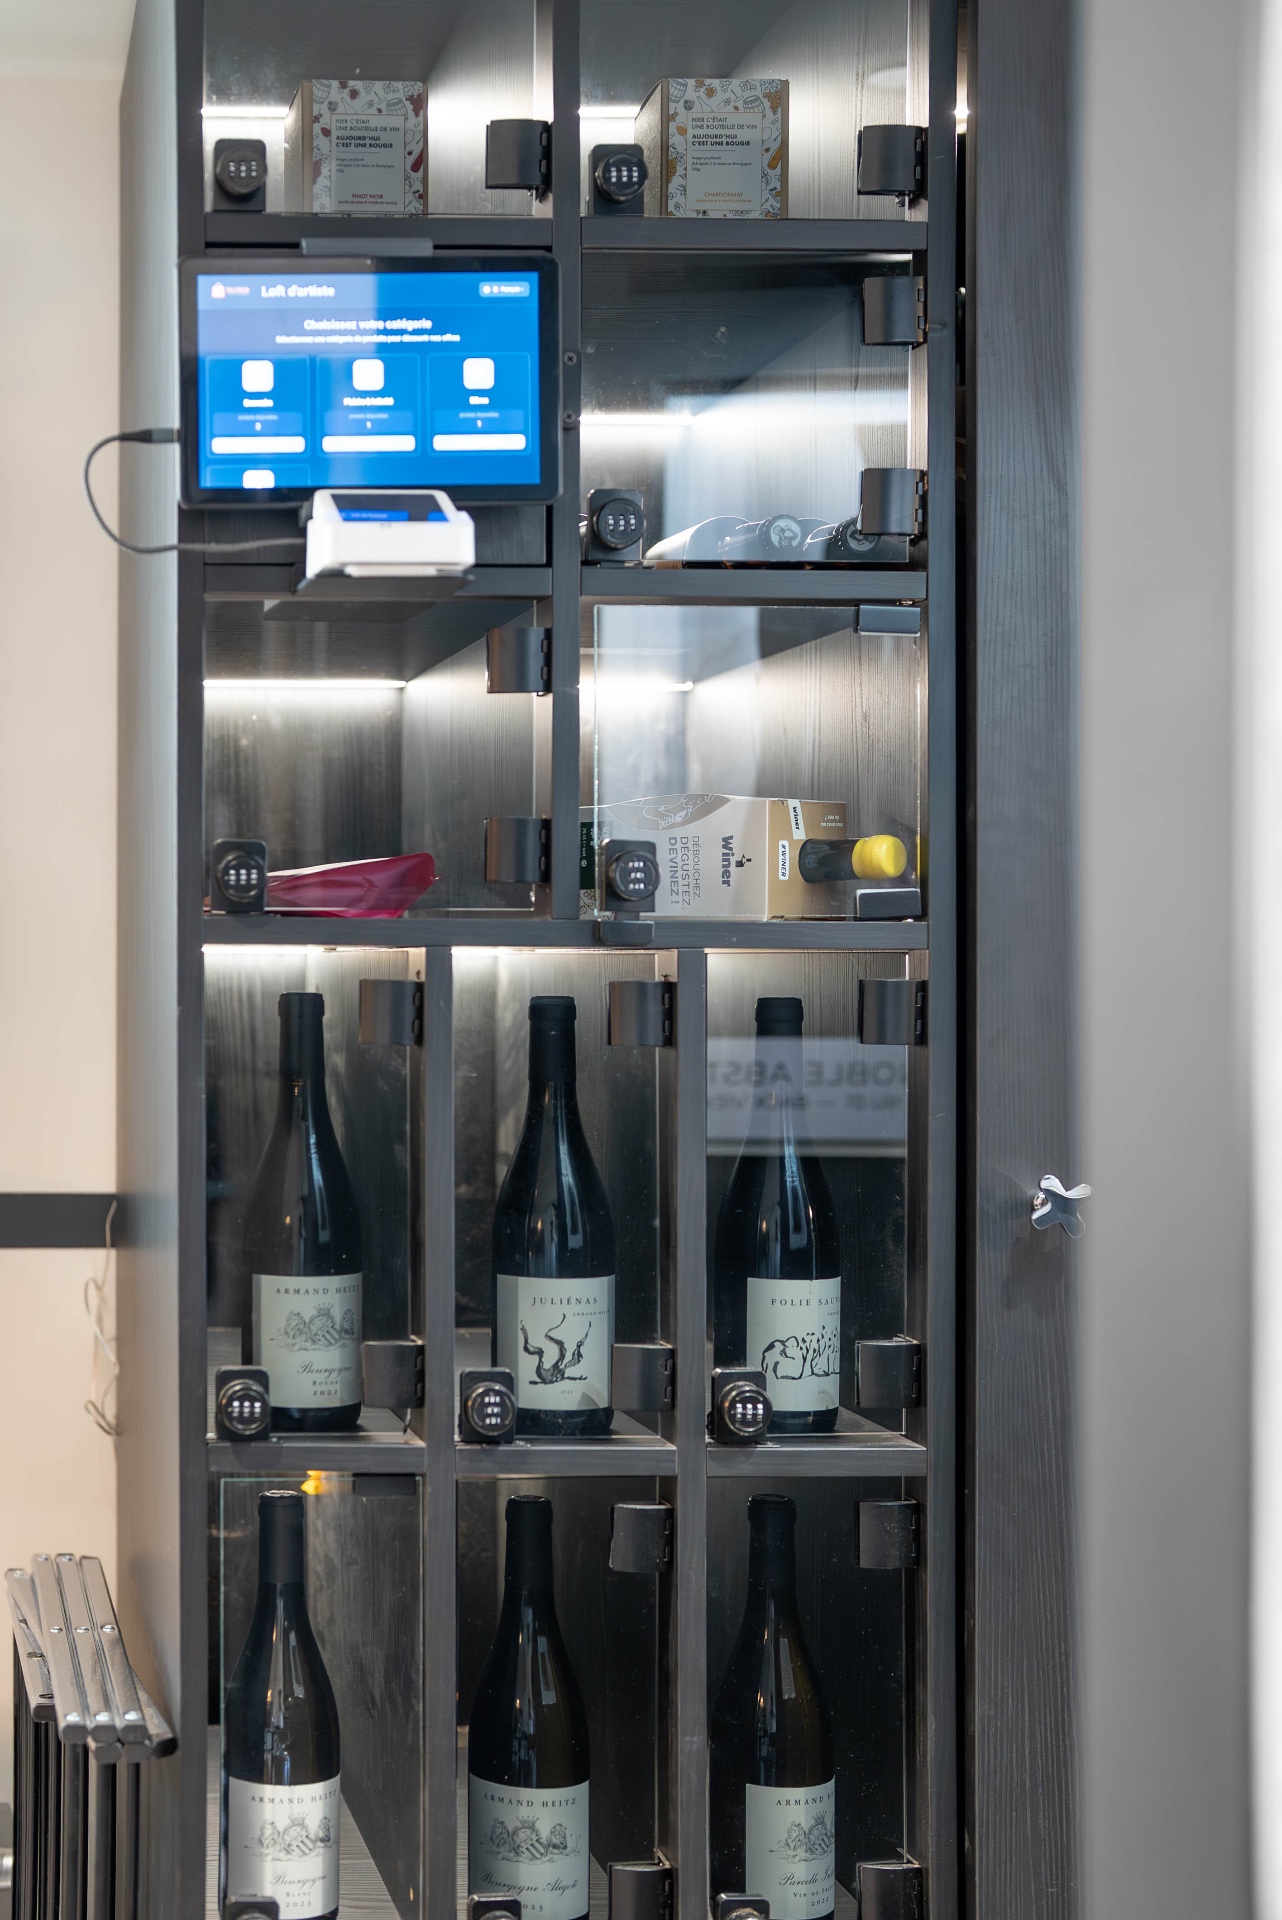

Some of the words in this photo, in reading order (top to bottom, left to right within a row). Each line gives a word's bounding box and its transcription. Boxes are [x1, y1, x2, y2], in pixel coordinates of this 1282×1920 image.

[261, 284, 286, 298] Loft
[287, 284, 335, 298] d'artiste
[669, 837, 679, 896] DEVINEZ
[722, 835, 734, 887] Winer
[532, 1296, 598, 1306] JULIÉNAS
[771, 1298, 811, 1306] FOLIE
[297, 1360, 352, 1378] Bourgogne
[250, 1795, 304, 1804] ARMAND
[311, 1789, 337, 1802] HEITZ
[484, 1792, 534, 1808] ARMAND
[542, 1798, 577, 1808] HEITZ
[776, 1796, 824, 1806] ARMAND
[270, 1871, 327, 1890] Bourgogne
[481, 1870, 539, 1896] Bourgogne
[811, 1897, 829, 1906] 2022
